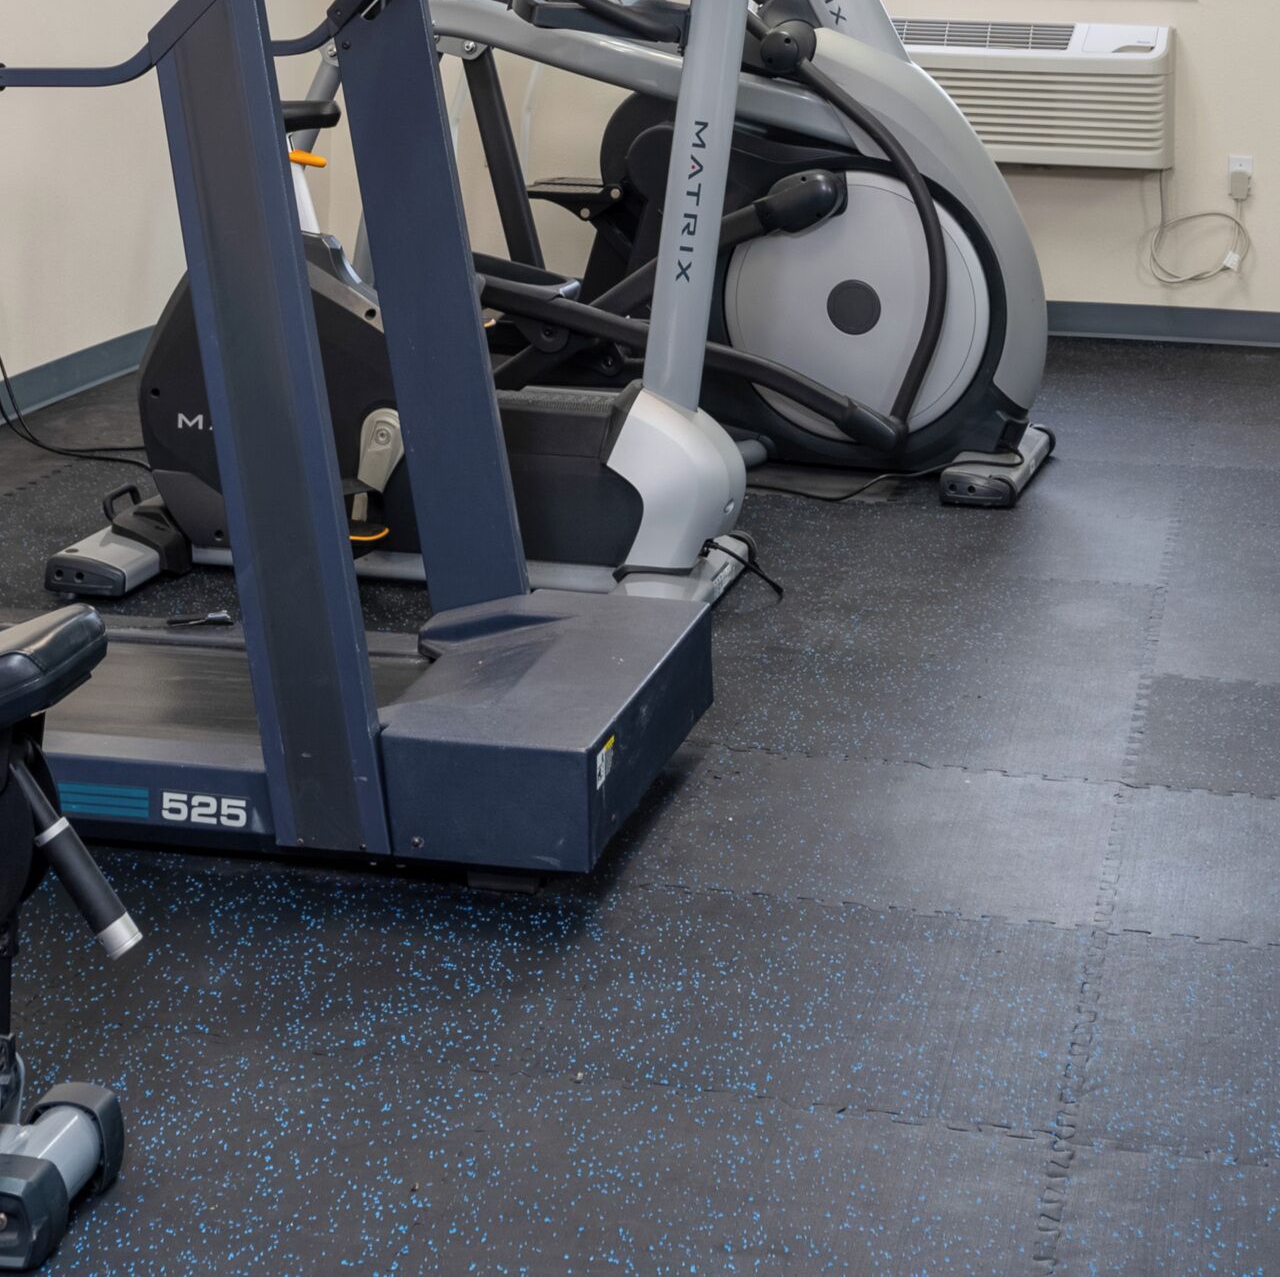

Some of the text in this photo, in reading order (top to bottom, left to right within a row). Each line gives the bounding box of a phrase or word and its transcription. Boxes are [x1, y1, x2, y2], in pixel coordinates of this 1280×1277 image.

[675, 120, 709, 283] MATRIX
[177, 412, 213, 430] M
[161, 791, 247, 828] 525
